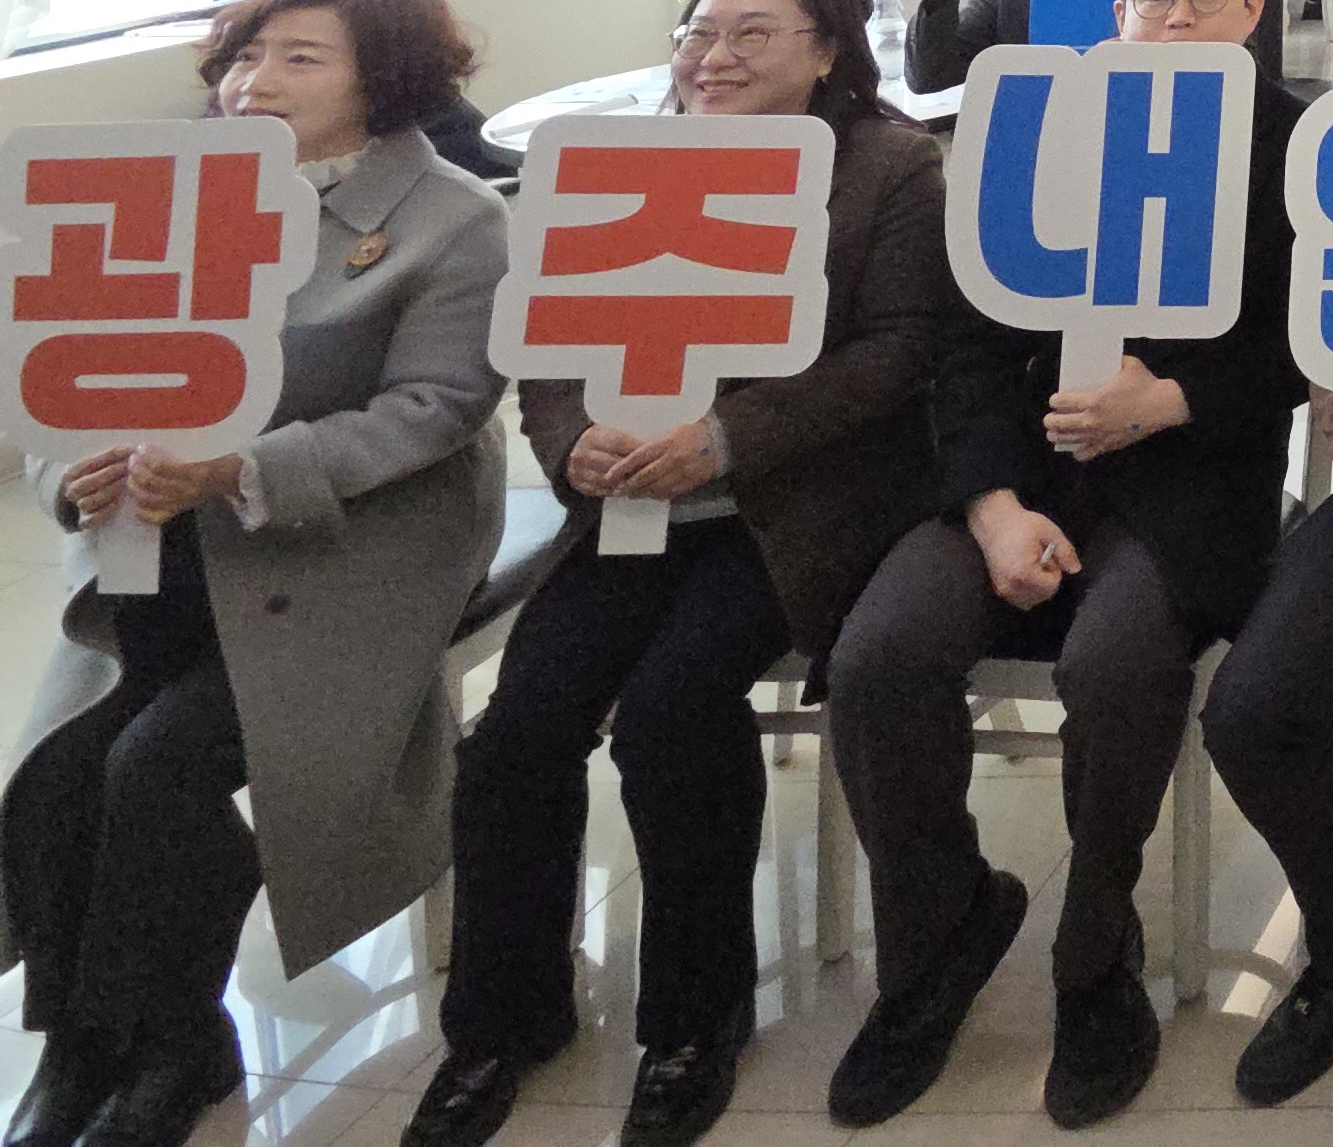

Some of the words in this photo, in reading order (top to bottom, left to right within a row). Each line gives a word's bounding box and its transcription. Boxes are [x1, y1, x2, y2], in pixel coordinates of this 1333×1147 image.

[17, 156, 279, 428] 광
[527, 149, 796, 394] 주
[980, 73, 1221, 305] 내
